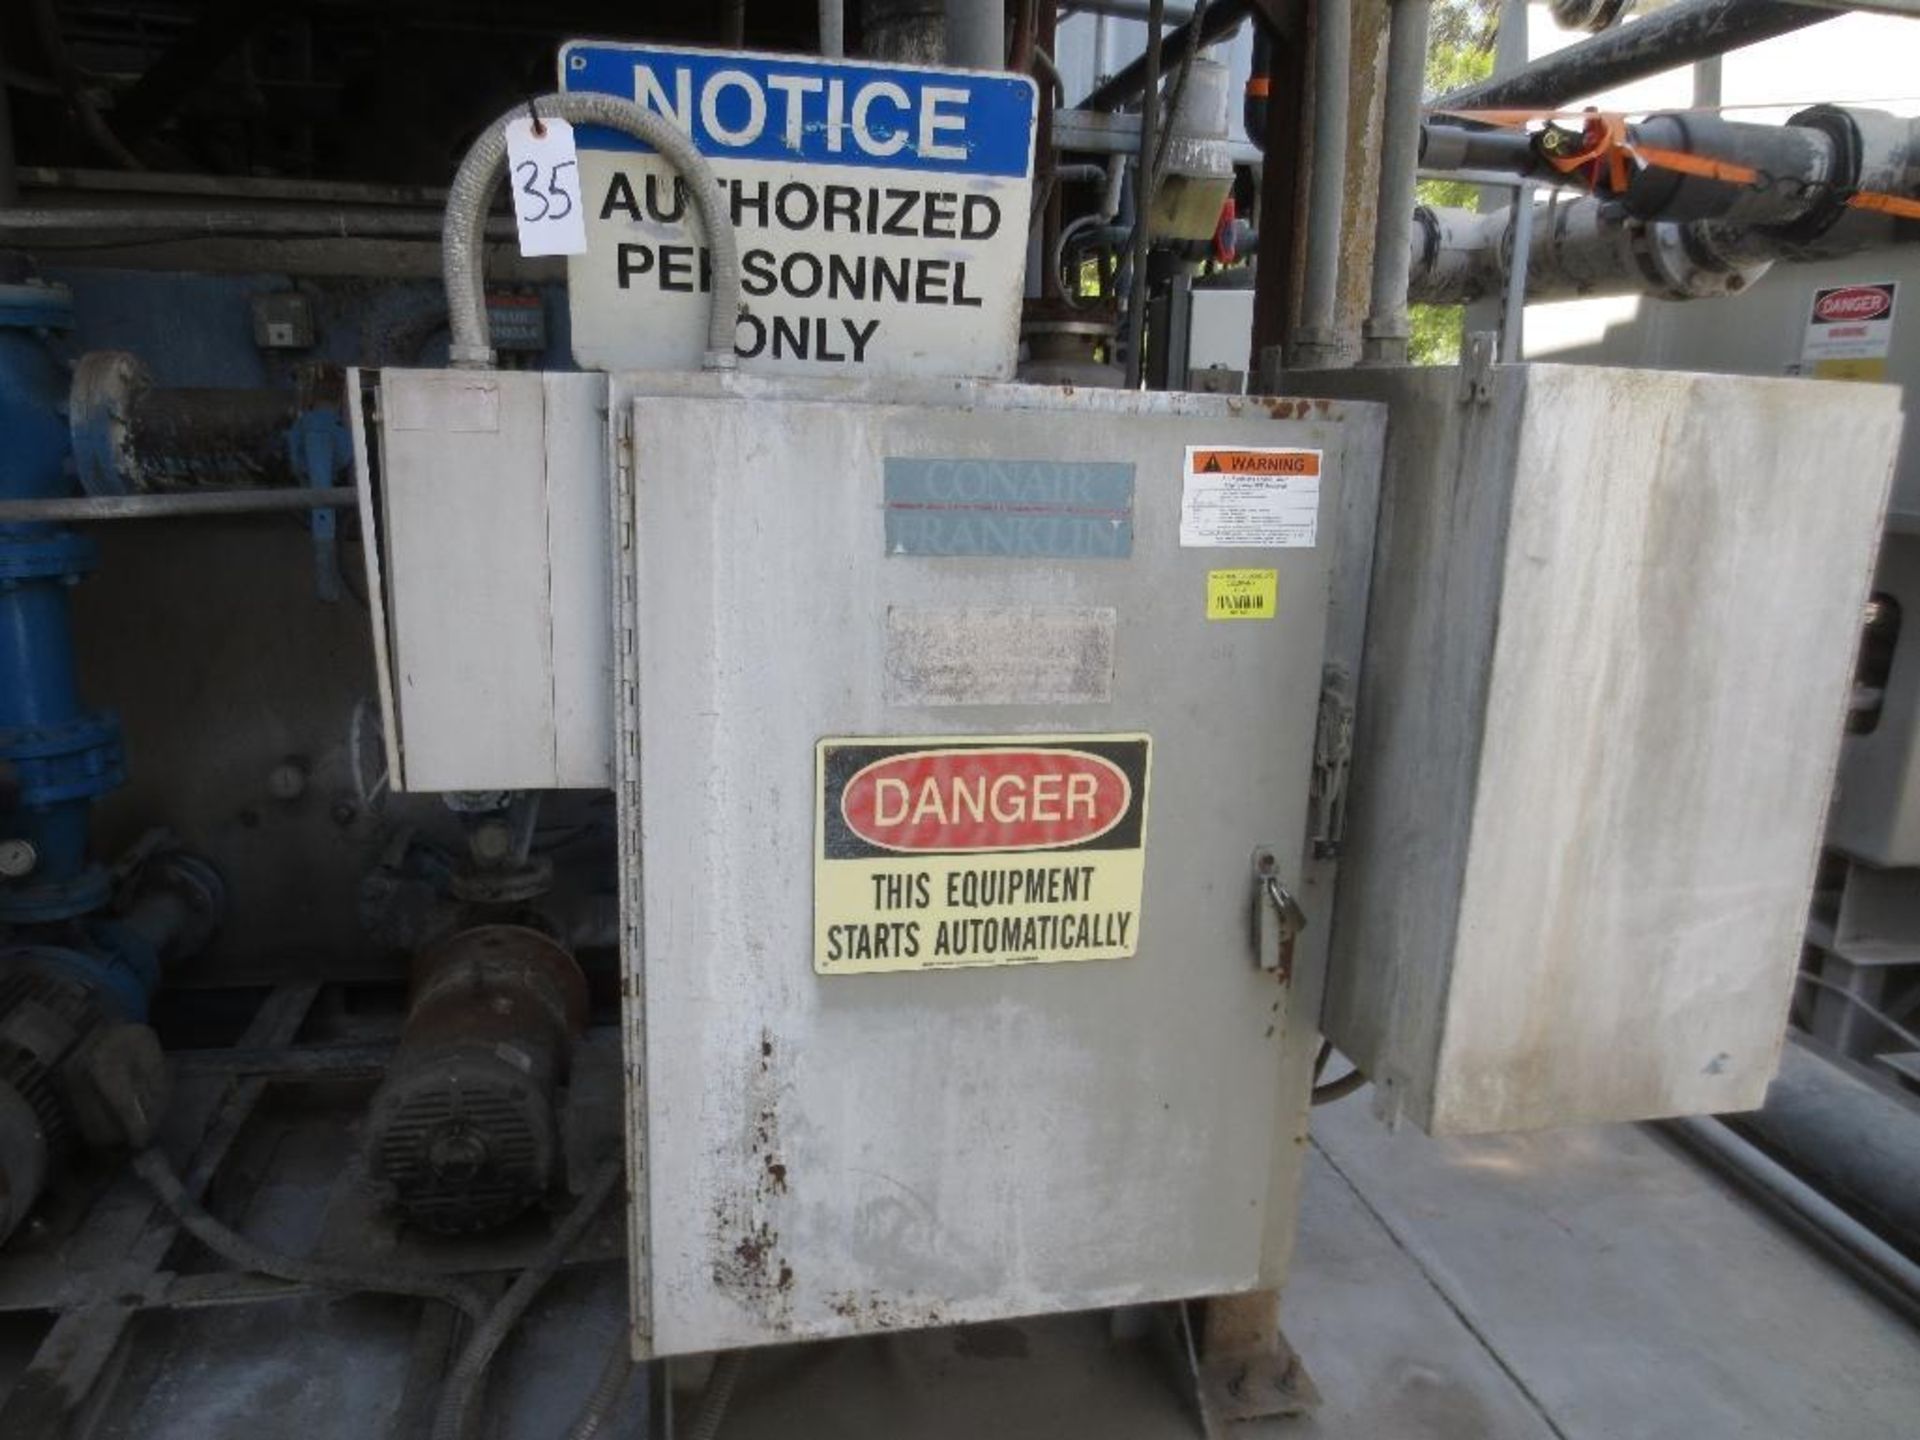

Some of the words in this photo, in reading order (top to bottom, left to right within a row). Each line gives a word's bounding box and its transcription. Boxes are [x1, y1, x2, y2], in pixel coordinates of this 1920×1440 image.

[633, 64, 971, 160] NOTICE
[516, 160, 575, 222] 35
[600, 172, 1001, 240] AUHORIZED
[1822, 295, 1883, 314] DANGER
[733, 314, 880, 363] ONLY
[925, 462, 1095, 502] CONAIR
[1231, 457, 1305, 472] WARNING
[890, 515, 1124, 554] FRANKLIN
[874, 773, 1098, 827] DANGER
[871, 872, 930, 910] THIS
[946, 866, 1095, 908] EQUIPMENT
[827, 921, 920, 961] STARTS
[934, 911, 1132, 956] AUTOMATICALLY
